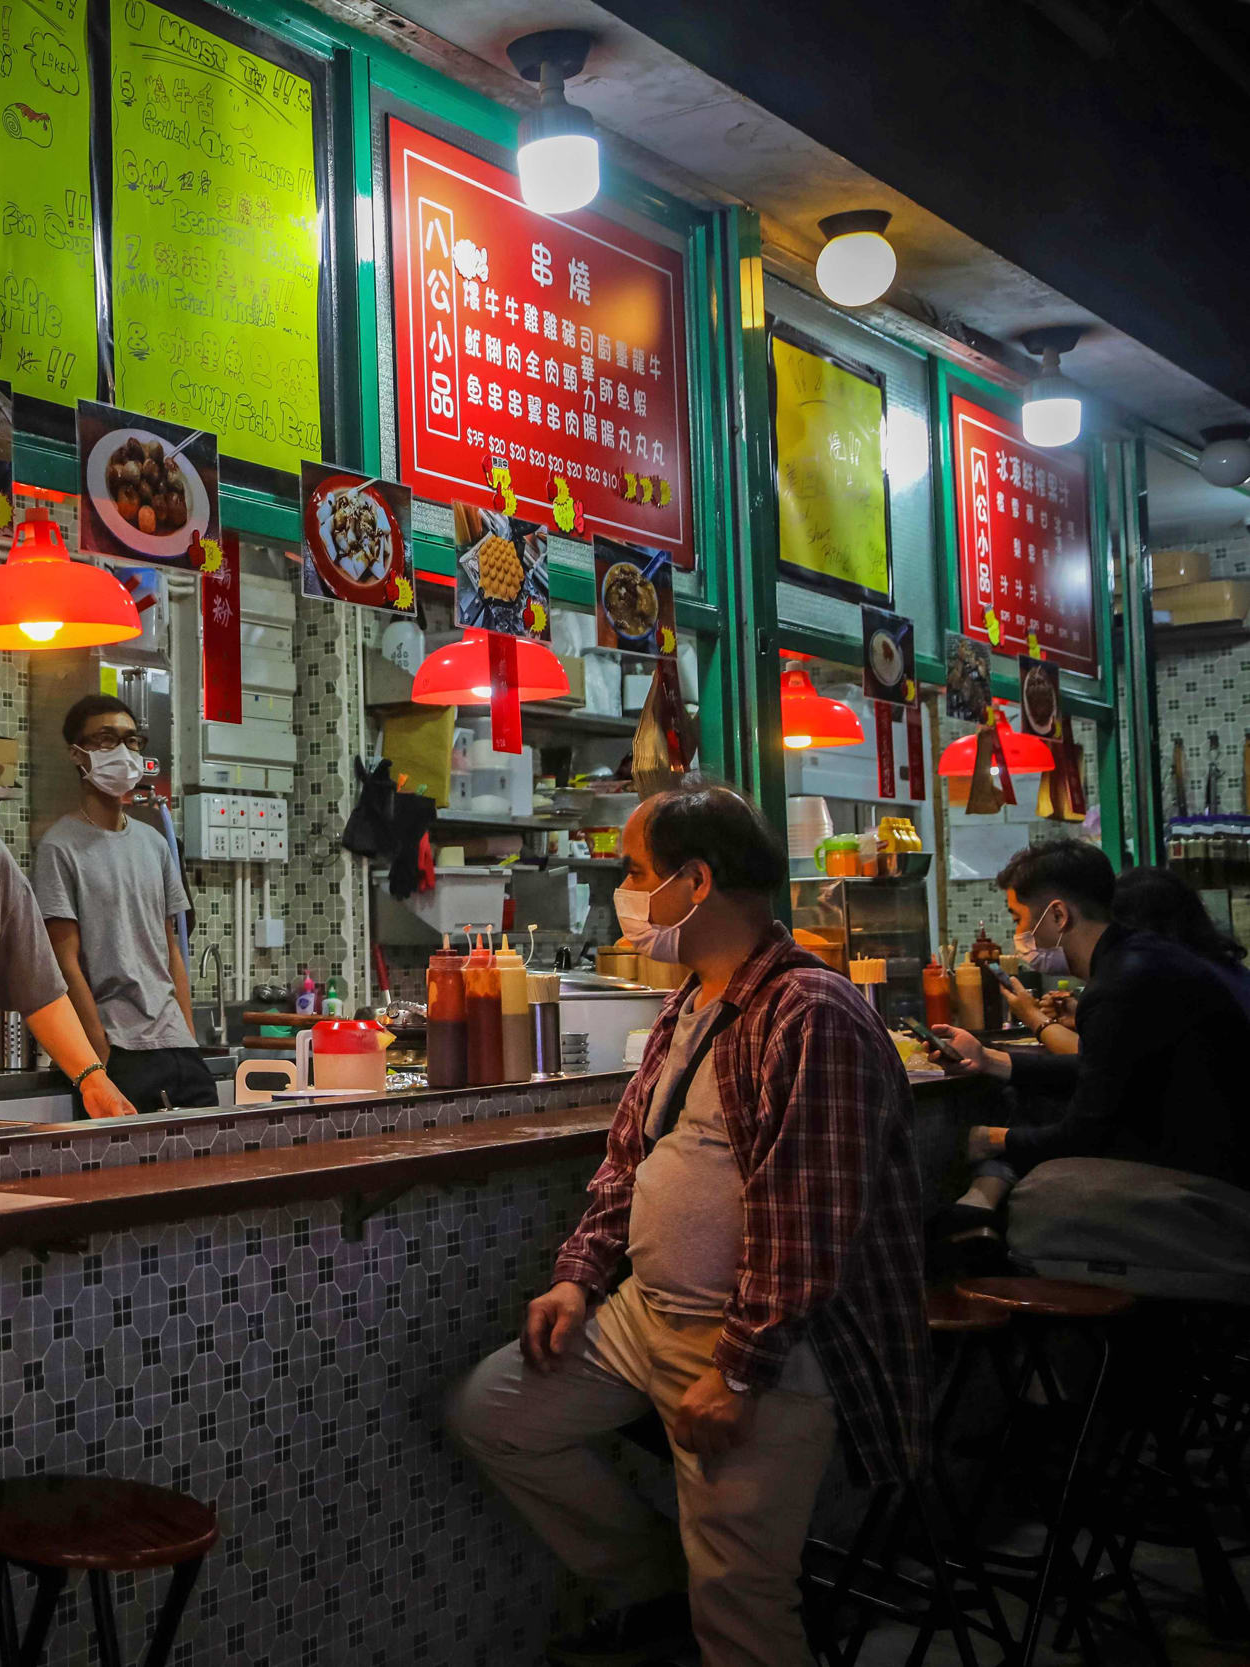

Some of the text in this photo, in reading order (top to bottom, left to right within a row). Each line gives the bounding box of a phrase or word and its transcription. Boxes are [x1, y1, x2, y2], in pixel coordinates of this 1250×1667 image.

[425, 217, 455, 419] 八公小品
[504, 295, 523, 419] 牛肉串
[523, 303, 543, 427] 雞全翼
[543, 310, 562, 432] 雞肉串
[579, 326, 598, 443] 司華力腸
[632, 348, 649, 460] 龍蝦丸
[466, 427, 485, 449] $35
[488, 435, 506, 456] $20
[509, 440, 526, 462] $20
[529, 446, 546, 468] $20
[548, 452, 564, 473] $20
[566, 458, 582, 479] $20
[585, 464, 600, 484] $20
[602, 469, 618, 490] $10
[974, 459, 992, 594] 八公小品
